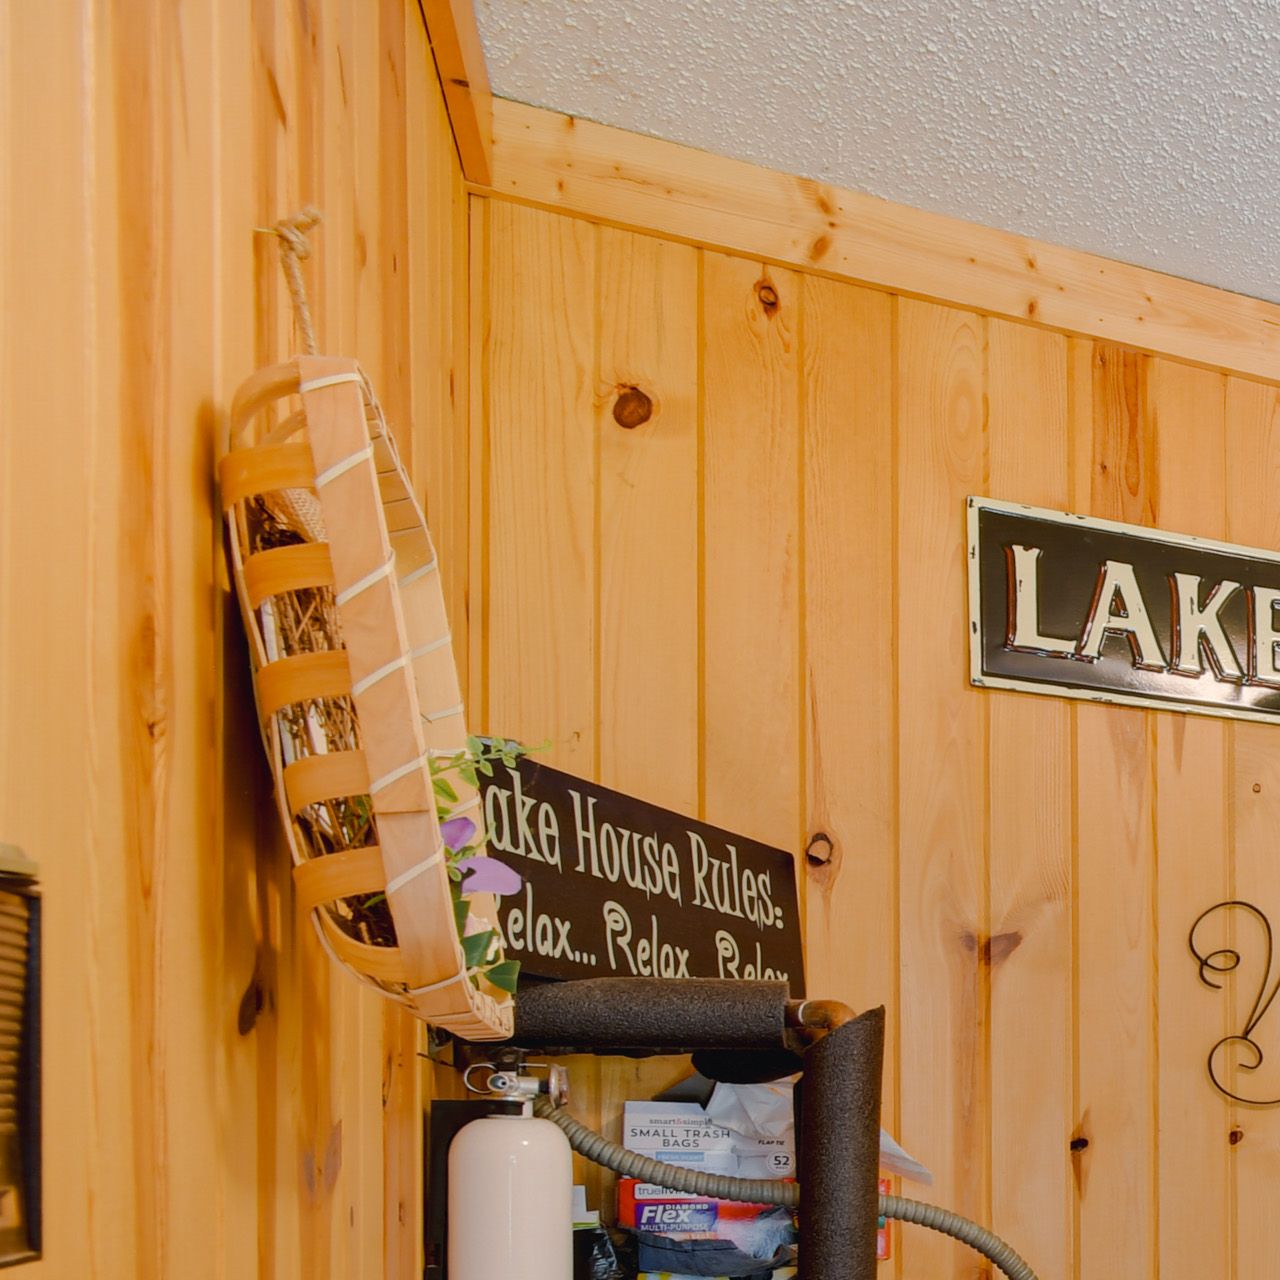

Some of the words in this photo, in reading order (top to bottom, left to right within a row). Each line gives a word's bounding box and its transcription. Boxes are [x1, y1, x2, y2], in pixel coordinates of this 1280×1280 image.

[485, 767, 562, 874] ake
[567, 789, 683, 907] House
[686, 830, 784, 932] Rules:
[630, 1128, 677, 1137] SMALL
[684, 1129, 730, 1138] TRASH
[662, 1138, 700, 1148] BAGS
[773, 1155, 790, 1166] 52
[641, 1204, 693, 1224] Flex
